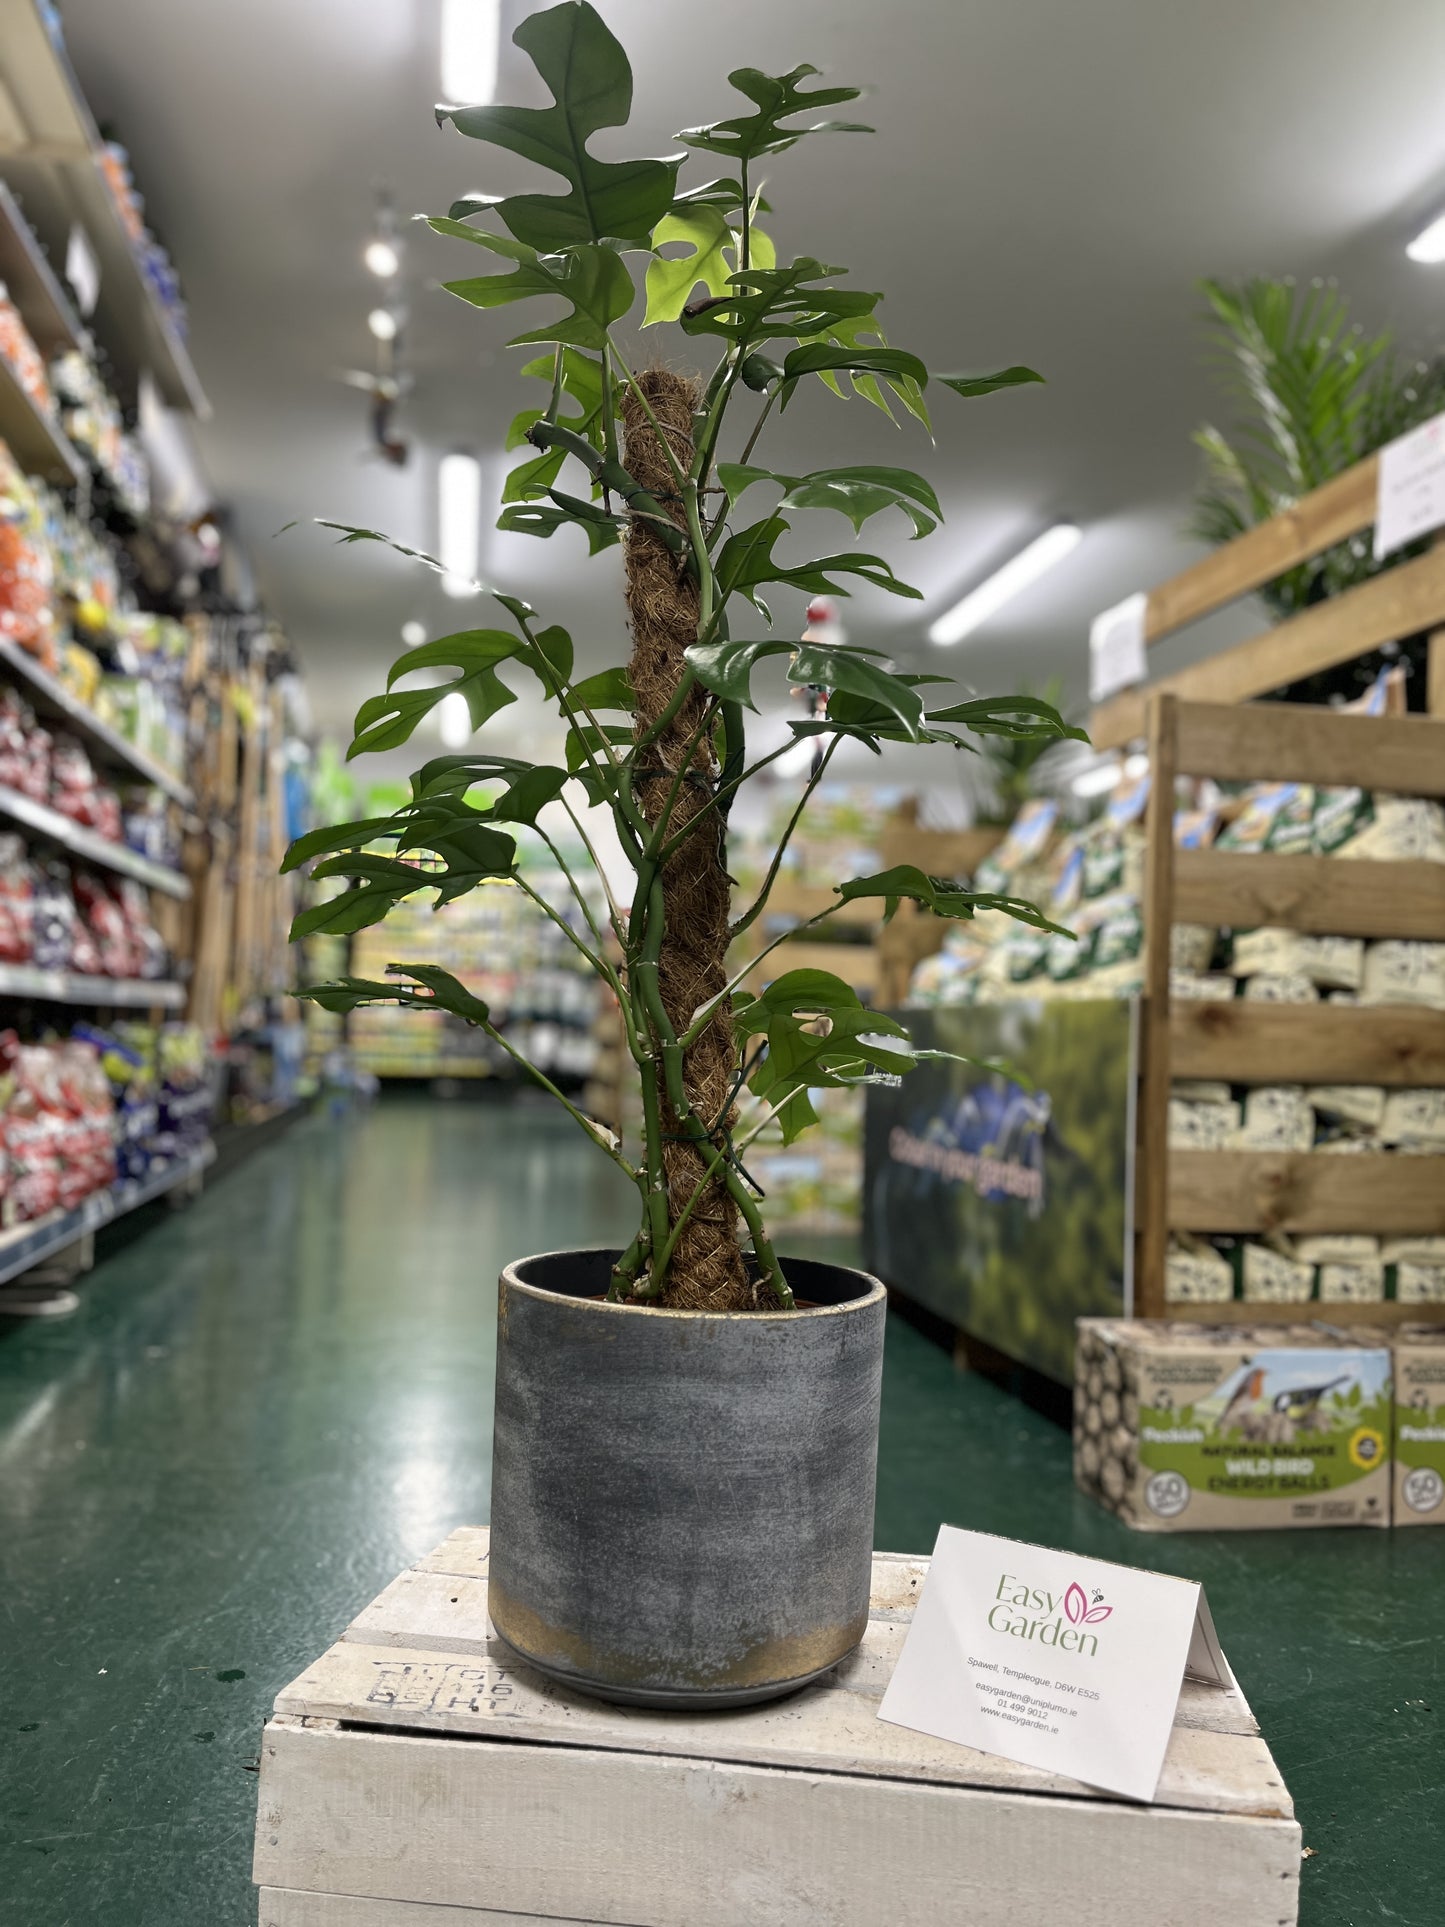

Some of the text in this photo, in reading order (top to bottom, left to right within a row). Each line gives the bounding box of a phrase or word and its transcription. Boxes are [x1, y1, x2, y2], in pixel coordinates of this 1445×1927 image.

[1201, 1445, 1336, 1457] NATURAL BALANCE
[1225, 1458, 1315, 1476] WILD BIRD
[1208, 1475, 1330, 1491] ENERGY BALLS
[995, 1573, 1063, 1620] Easy
[988, 1604, 1099, 1657] Garden
[967, 1656, 1101, 1701] Spawell, Templeogue, D6W E525
[447, 1696, 509, 1710] HT
[975, 1681, 1078, 1717] easygarden@uniplumo.ie
[997, 1698, 1049, 1720] 01 499 9012
[980, 1705, 1059, 1734] www.easygarden.ie
